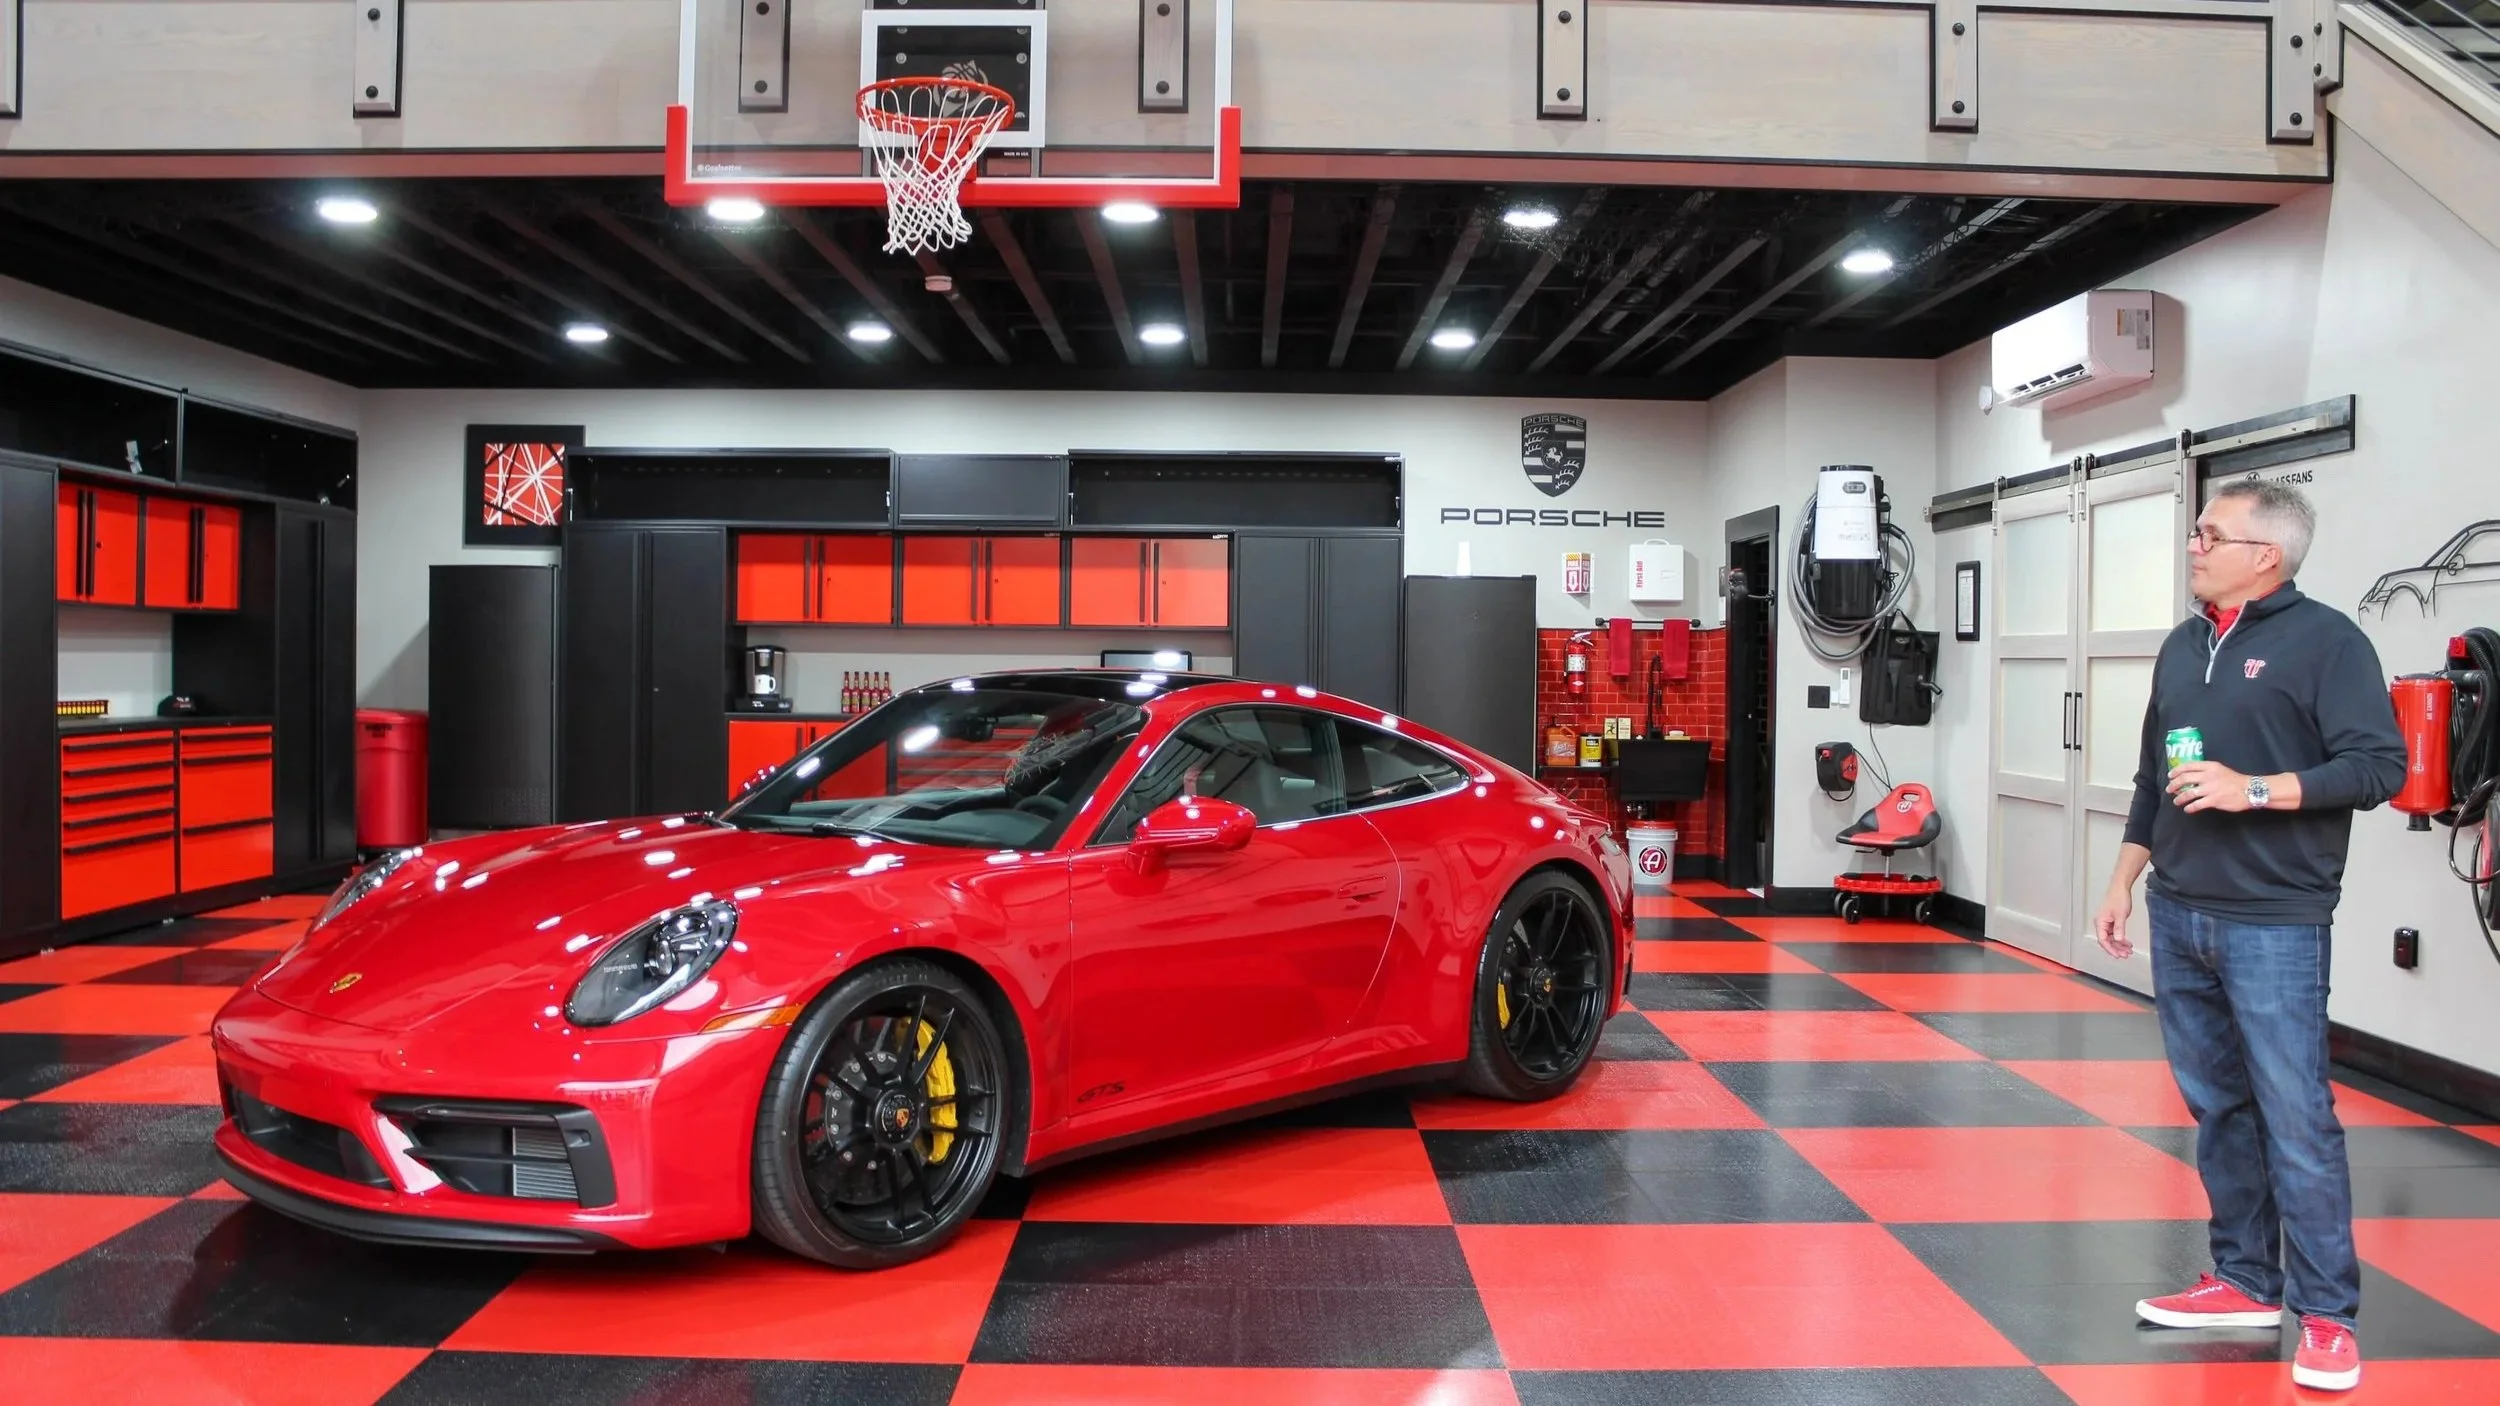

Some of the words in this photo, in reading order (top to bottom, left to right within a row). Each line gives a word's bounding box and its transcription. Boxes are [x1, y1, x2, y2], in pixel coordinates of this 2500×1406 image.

[1523, 415, 1584, 427] PORSCHE
[1441, 508, 1665, 528] PORSCHE
[1635, 560, 1644, 572] Aid
[1635, 572, 1644, 588] First
[1077, 1080, 1125, 1103] GTS
